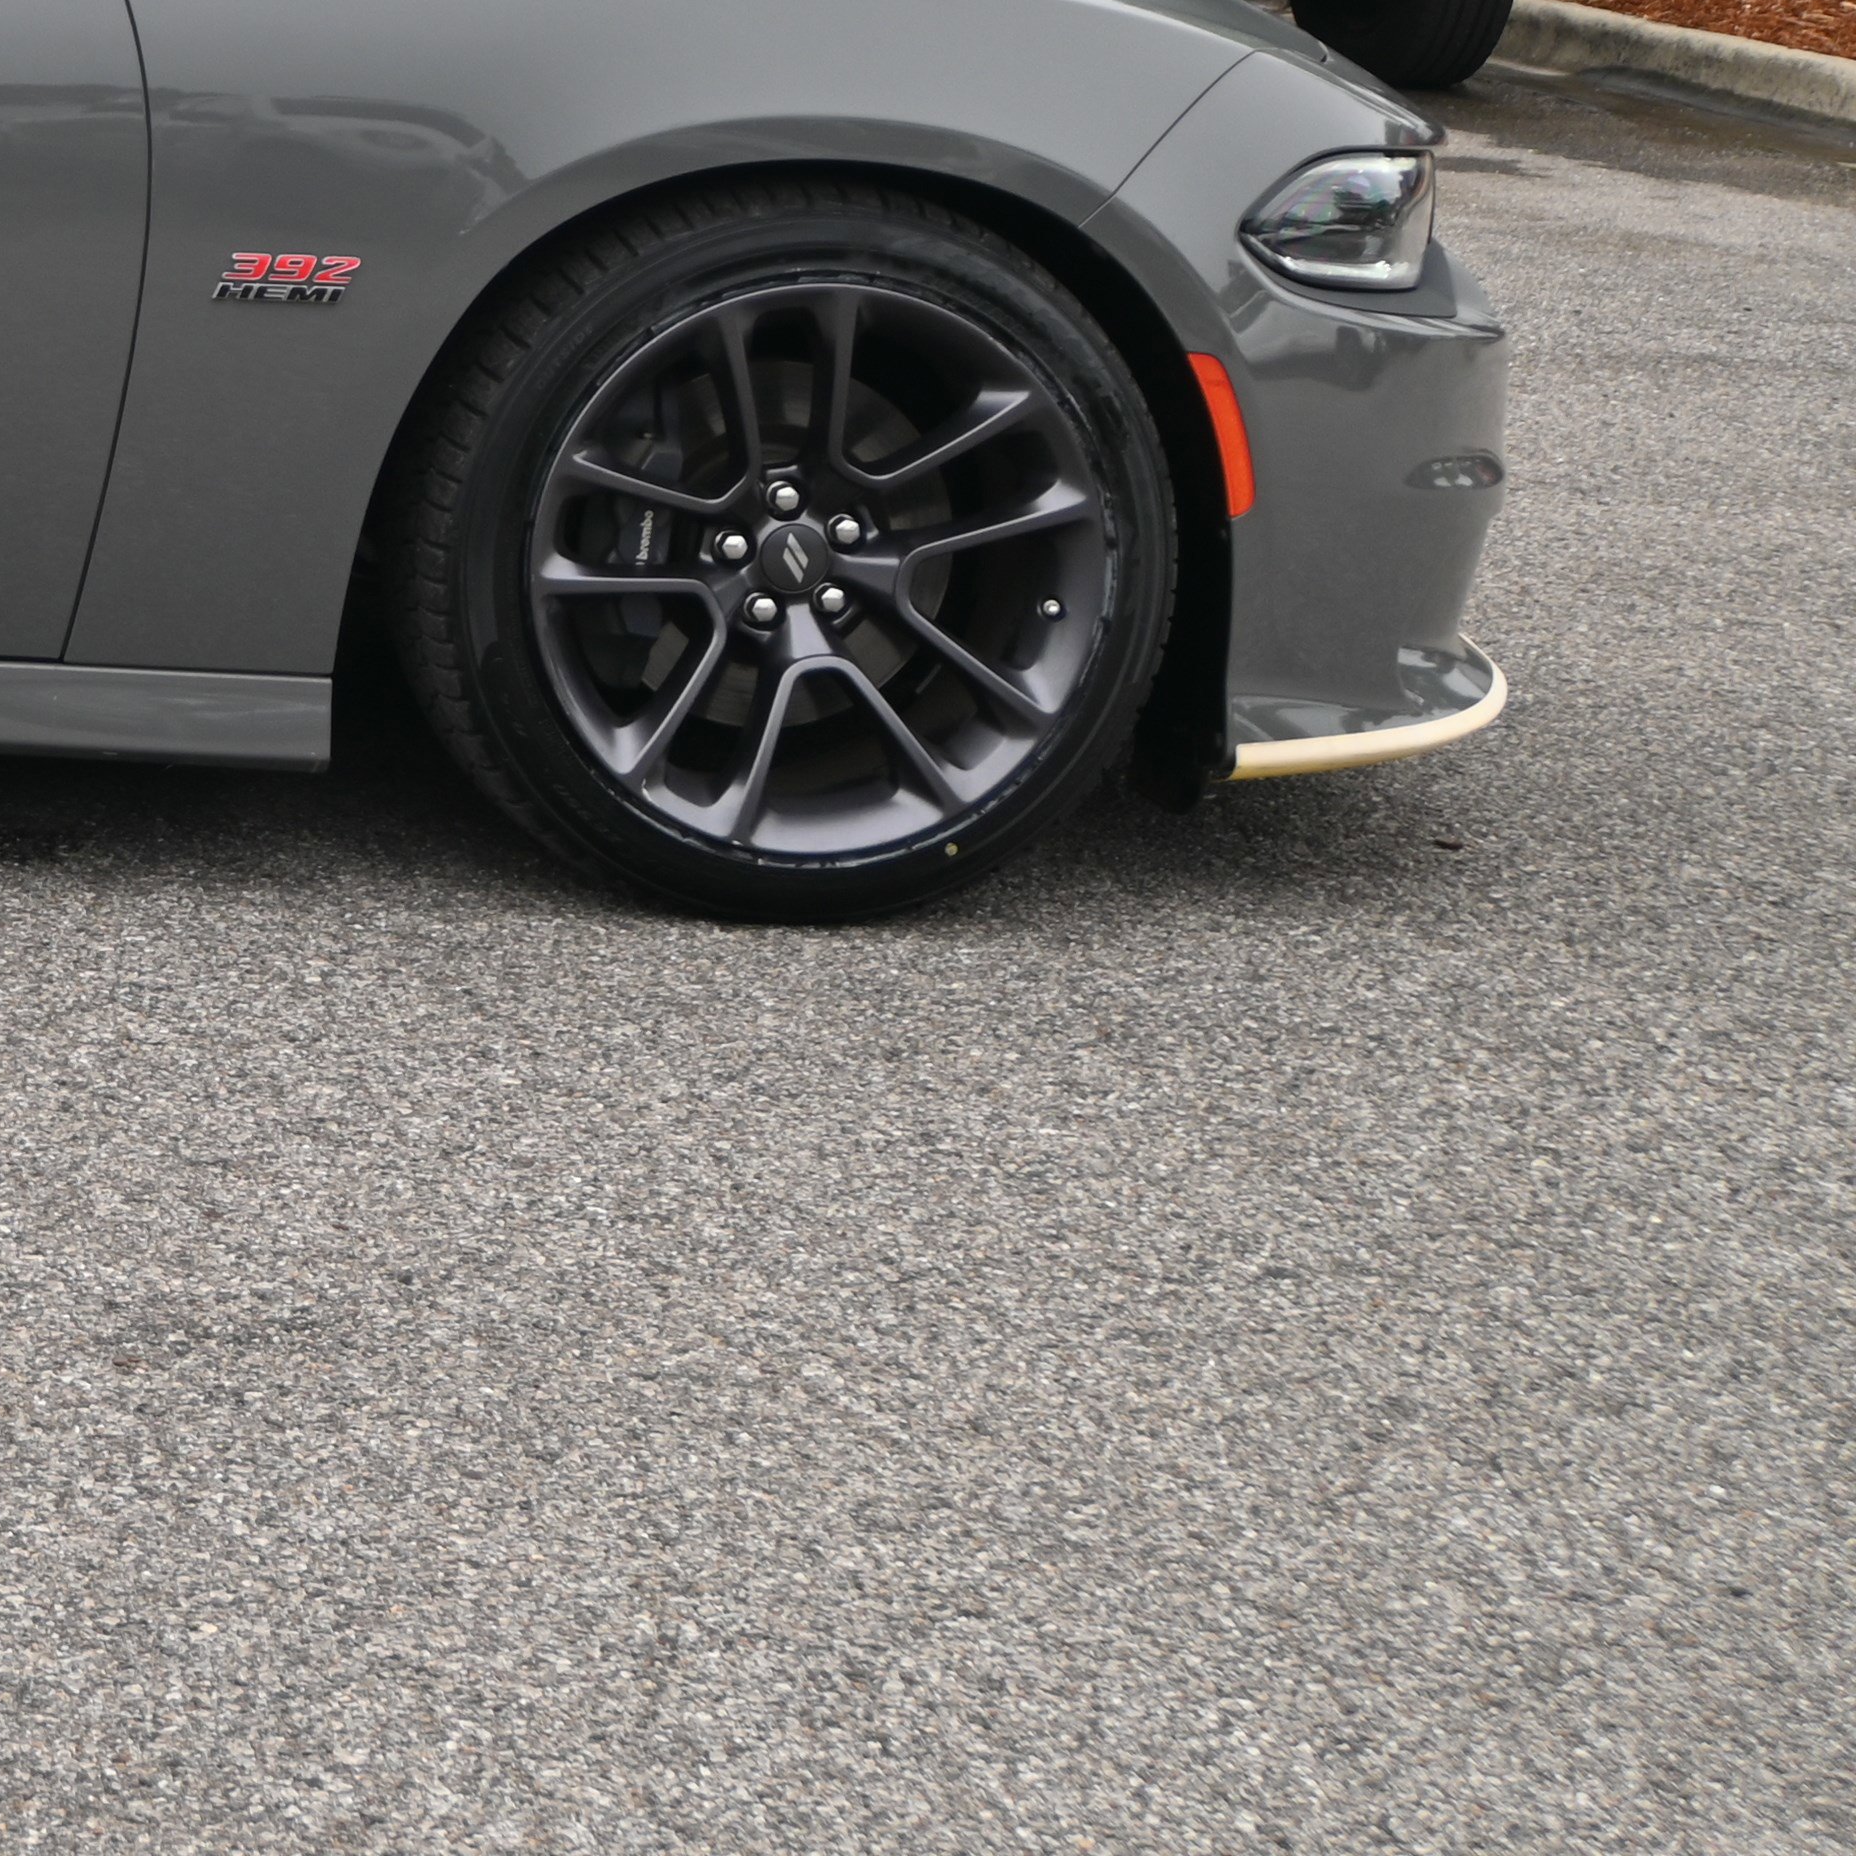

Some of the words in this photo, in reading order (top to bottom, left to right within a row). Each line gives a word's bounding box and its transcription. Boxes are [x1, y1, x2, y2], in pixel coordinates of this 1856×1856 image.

[222, 252, 361, 284] 392
[212, 281, 346, 303] HEMI
[634, 509, 655, 560] brembo
